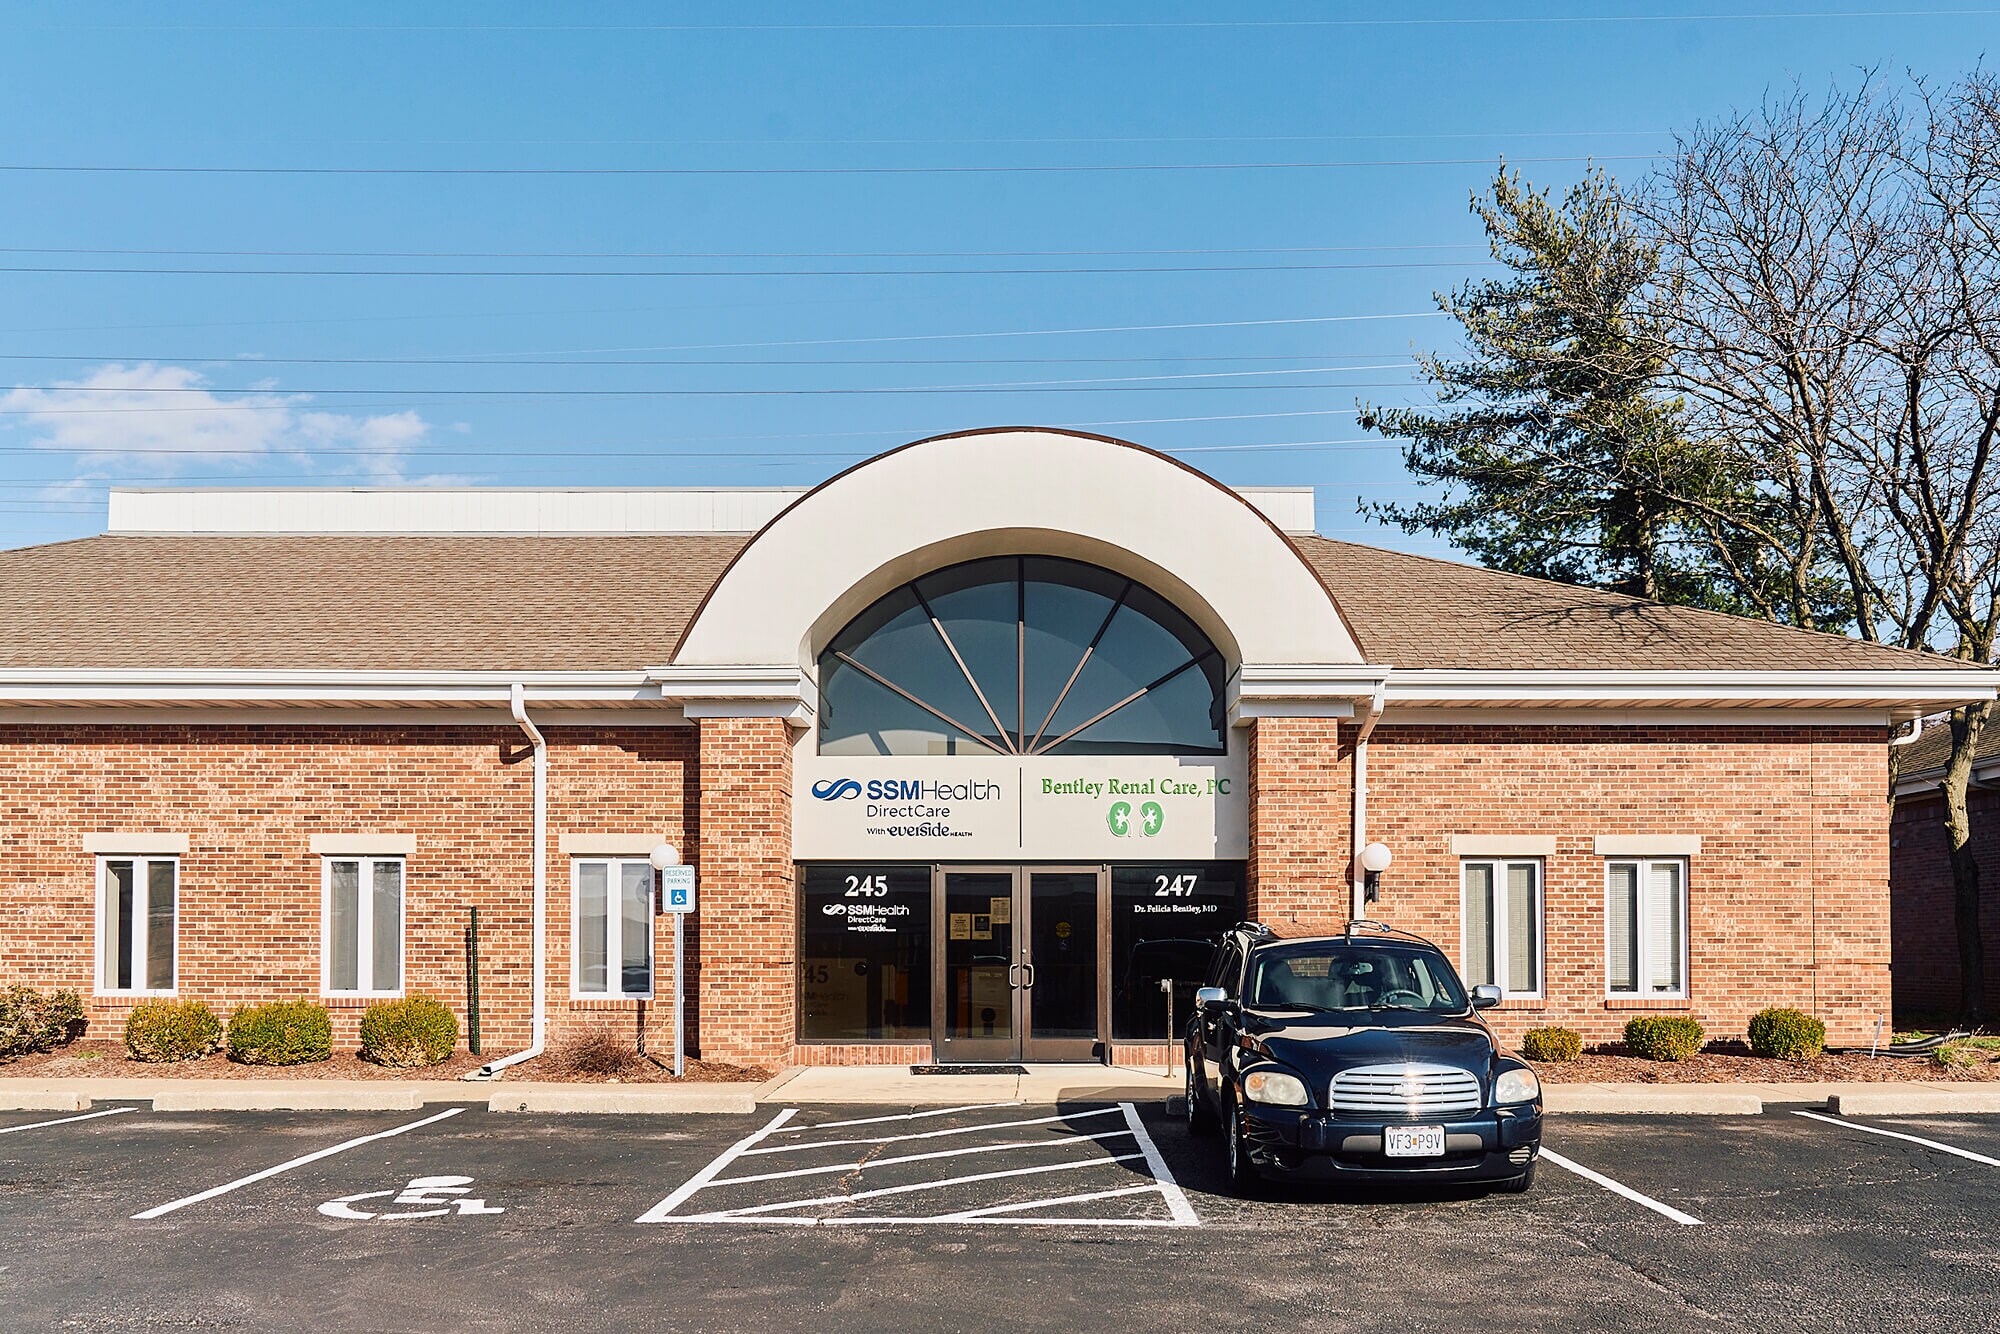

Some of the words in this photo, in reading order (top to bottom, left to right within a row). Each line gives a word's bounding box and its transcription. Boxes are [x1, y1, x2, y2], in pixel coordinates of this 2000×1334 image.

[1041, 778, 1103, 799] Bentley
[1108, 778, 1156, 795] Renal
[1160, 778, 1202, 797] Care,
[1206, 778, 1231, 795] PC
[866, 804, 951, 818] DirectCare
[866, 827, 886, 836] With
[887, 822, 950, 837] everside
[844, 875, 888, 897] 245
[1154, 874, 1198, 897] 247
[1134, 905, 1146, 913] Dr.
[1147, 904, 1171, 913] Felicia
[1172, 904, 1201, 915] Bentley,
[1202, 904, 1218, 913] MD
[847, 915, 887, 924] DirectCare
[1388, 1133, 1412, 1150] VF3
[1418, 1133, 1441, 1150] P9V
